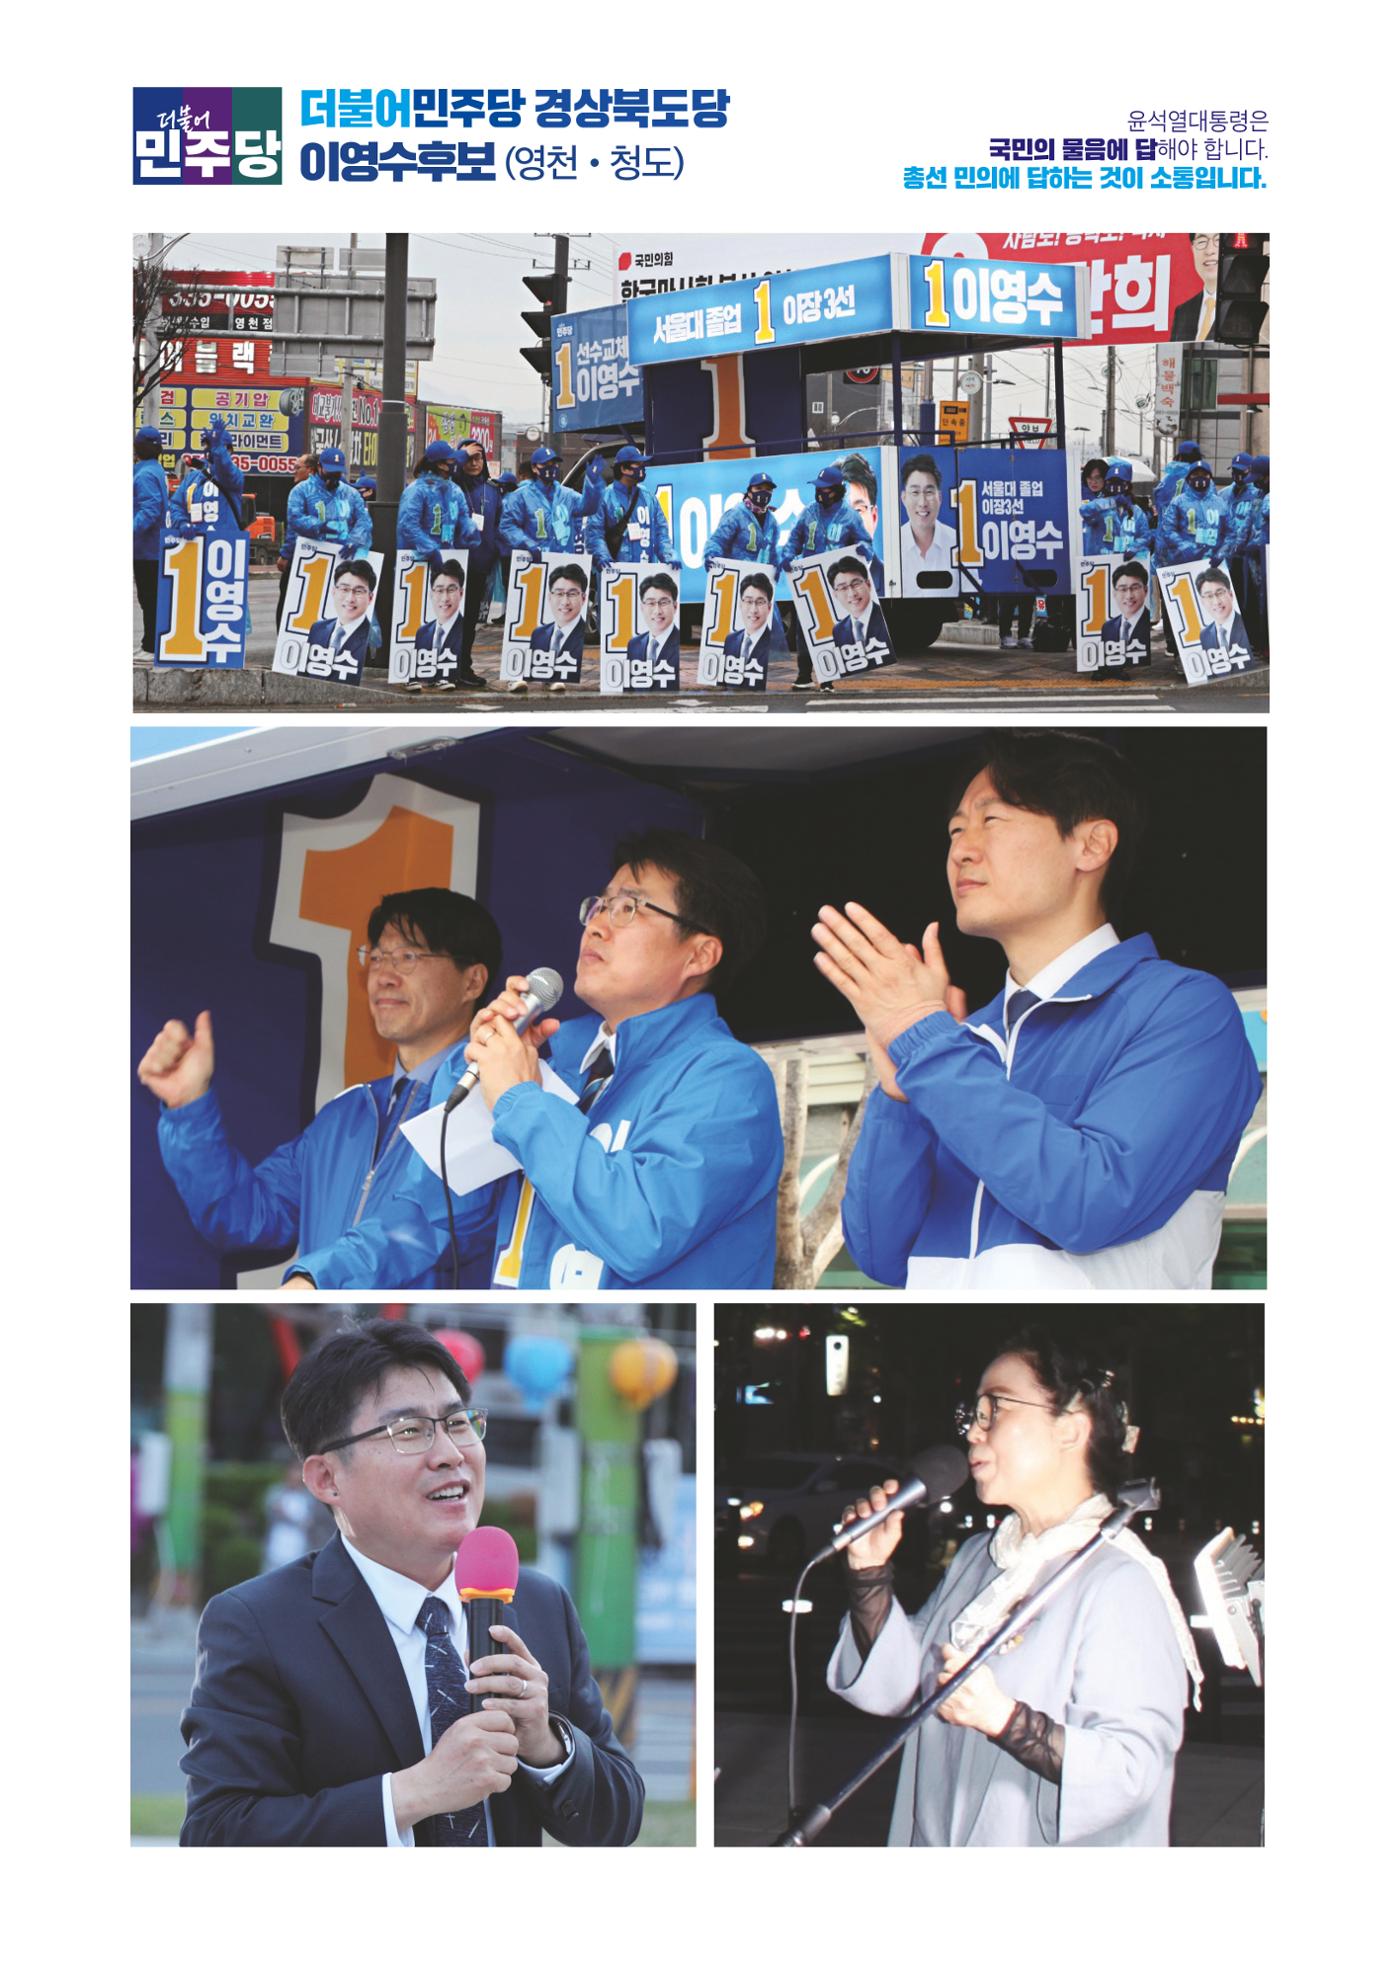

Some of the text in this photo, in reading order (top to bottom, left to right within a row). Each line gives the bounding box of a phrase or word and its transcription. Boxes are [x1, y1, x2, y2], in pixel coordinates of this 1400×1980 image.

[635, 252, 673, 268] 국민의힘
[923, 259, 1064, 327] 1 이영수
[653, 309, 704, 345] 서울대
[705, 303, 743, 336] 졸업
[753, 278, 775, 345] 1
[216, 392, 269, 407] 공기압
[555, 342, 576, 410] 1
[577, 361, 640, 402] 이영수
[430, 503, 442, 535] 1
[534, 507, 547, 538] 1
[982, 480, 1043, 497] 서울대 졸업
[1186, 508, 1197, 535] 1
[746, 523, 757, 552] 1
[807, 521, 817, 550] 1
[950, 478, 1064, 569] 1 이영수
[1103, 515, 1113, 542] 1
[159, 536, 246, 663] 1 이영수
[279, 551, 358, 680] 1 이영수
[393, 561, 458, 679] 1 이영수
[506, 562, 577, 679] 1 이영수
[606, 573, 676, 688] 1 이영수
[703, 569, 764, 687] 1 이영수
[793, 564, 890, 678] 1 이영수
[1081, 563, 1147, 667] 1 이영수
[1166, 572, 1251, 677] 1 이영수
